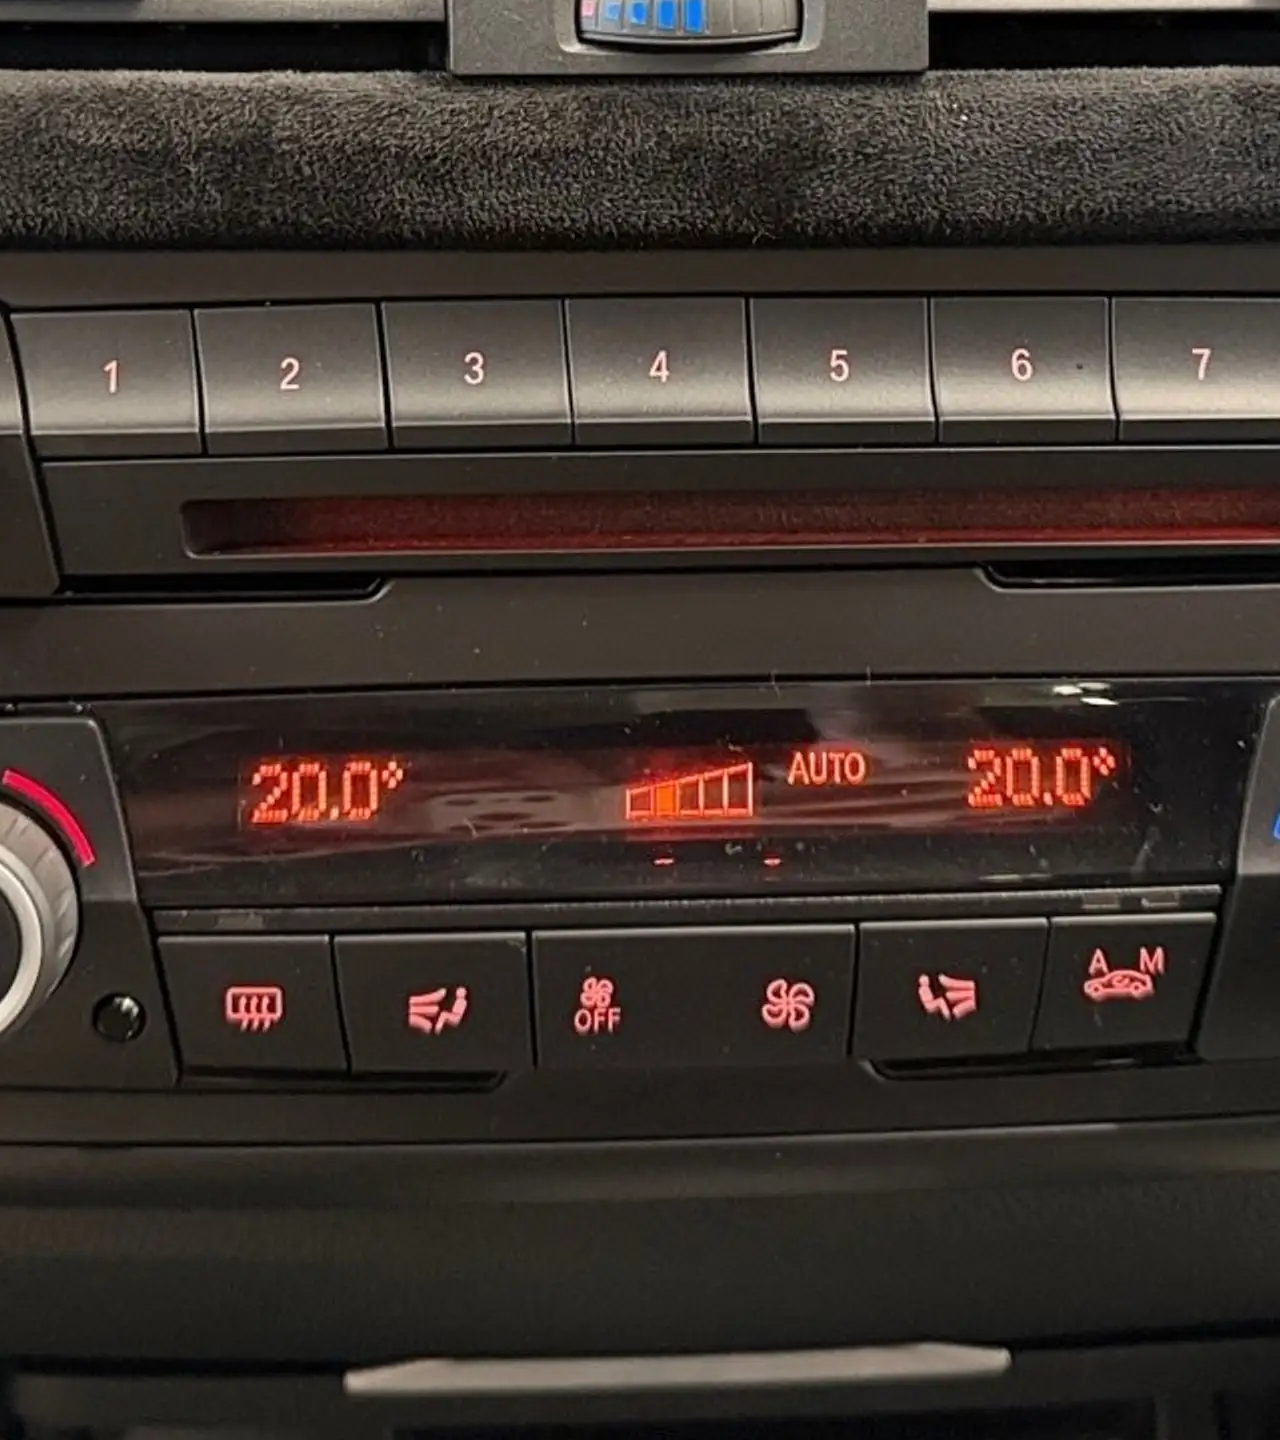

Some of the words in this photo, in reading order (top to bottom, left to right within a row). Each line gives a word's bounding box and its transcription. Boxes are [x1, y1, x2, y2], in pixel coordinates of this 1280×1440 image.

[103, 360, 118, 393] 1
[279, 358, 301, 390] 2
[463, 352, 485, 385] 3
[649, 350, 670, 383] 4
[829, 349, 850, 382] 5
[1010, 348, 1033, 380] 6
[1191, 348, 1211, 380] 7
[786, 750, 866, 786] AUTO
[574, 1008, 621, 1034] OFF
